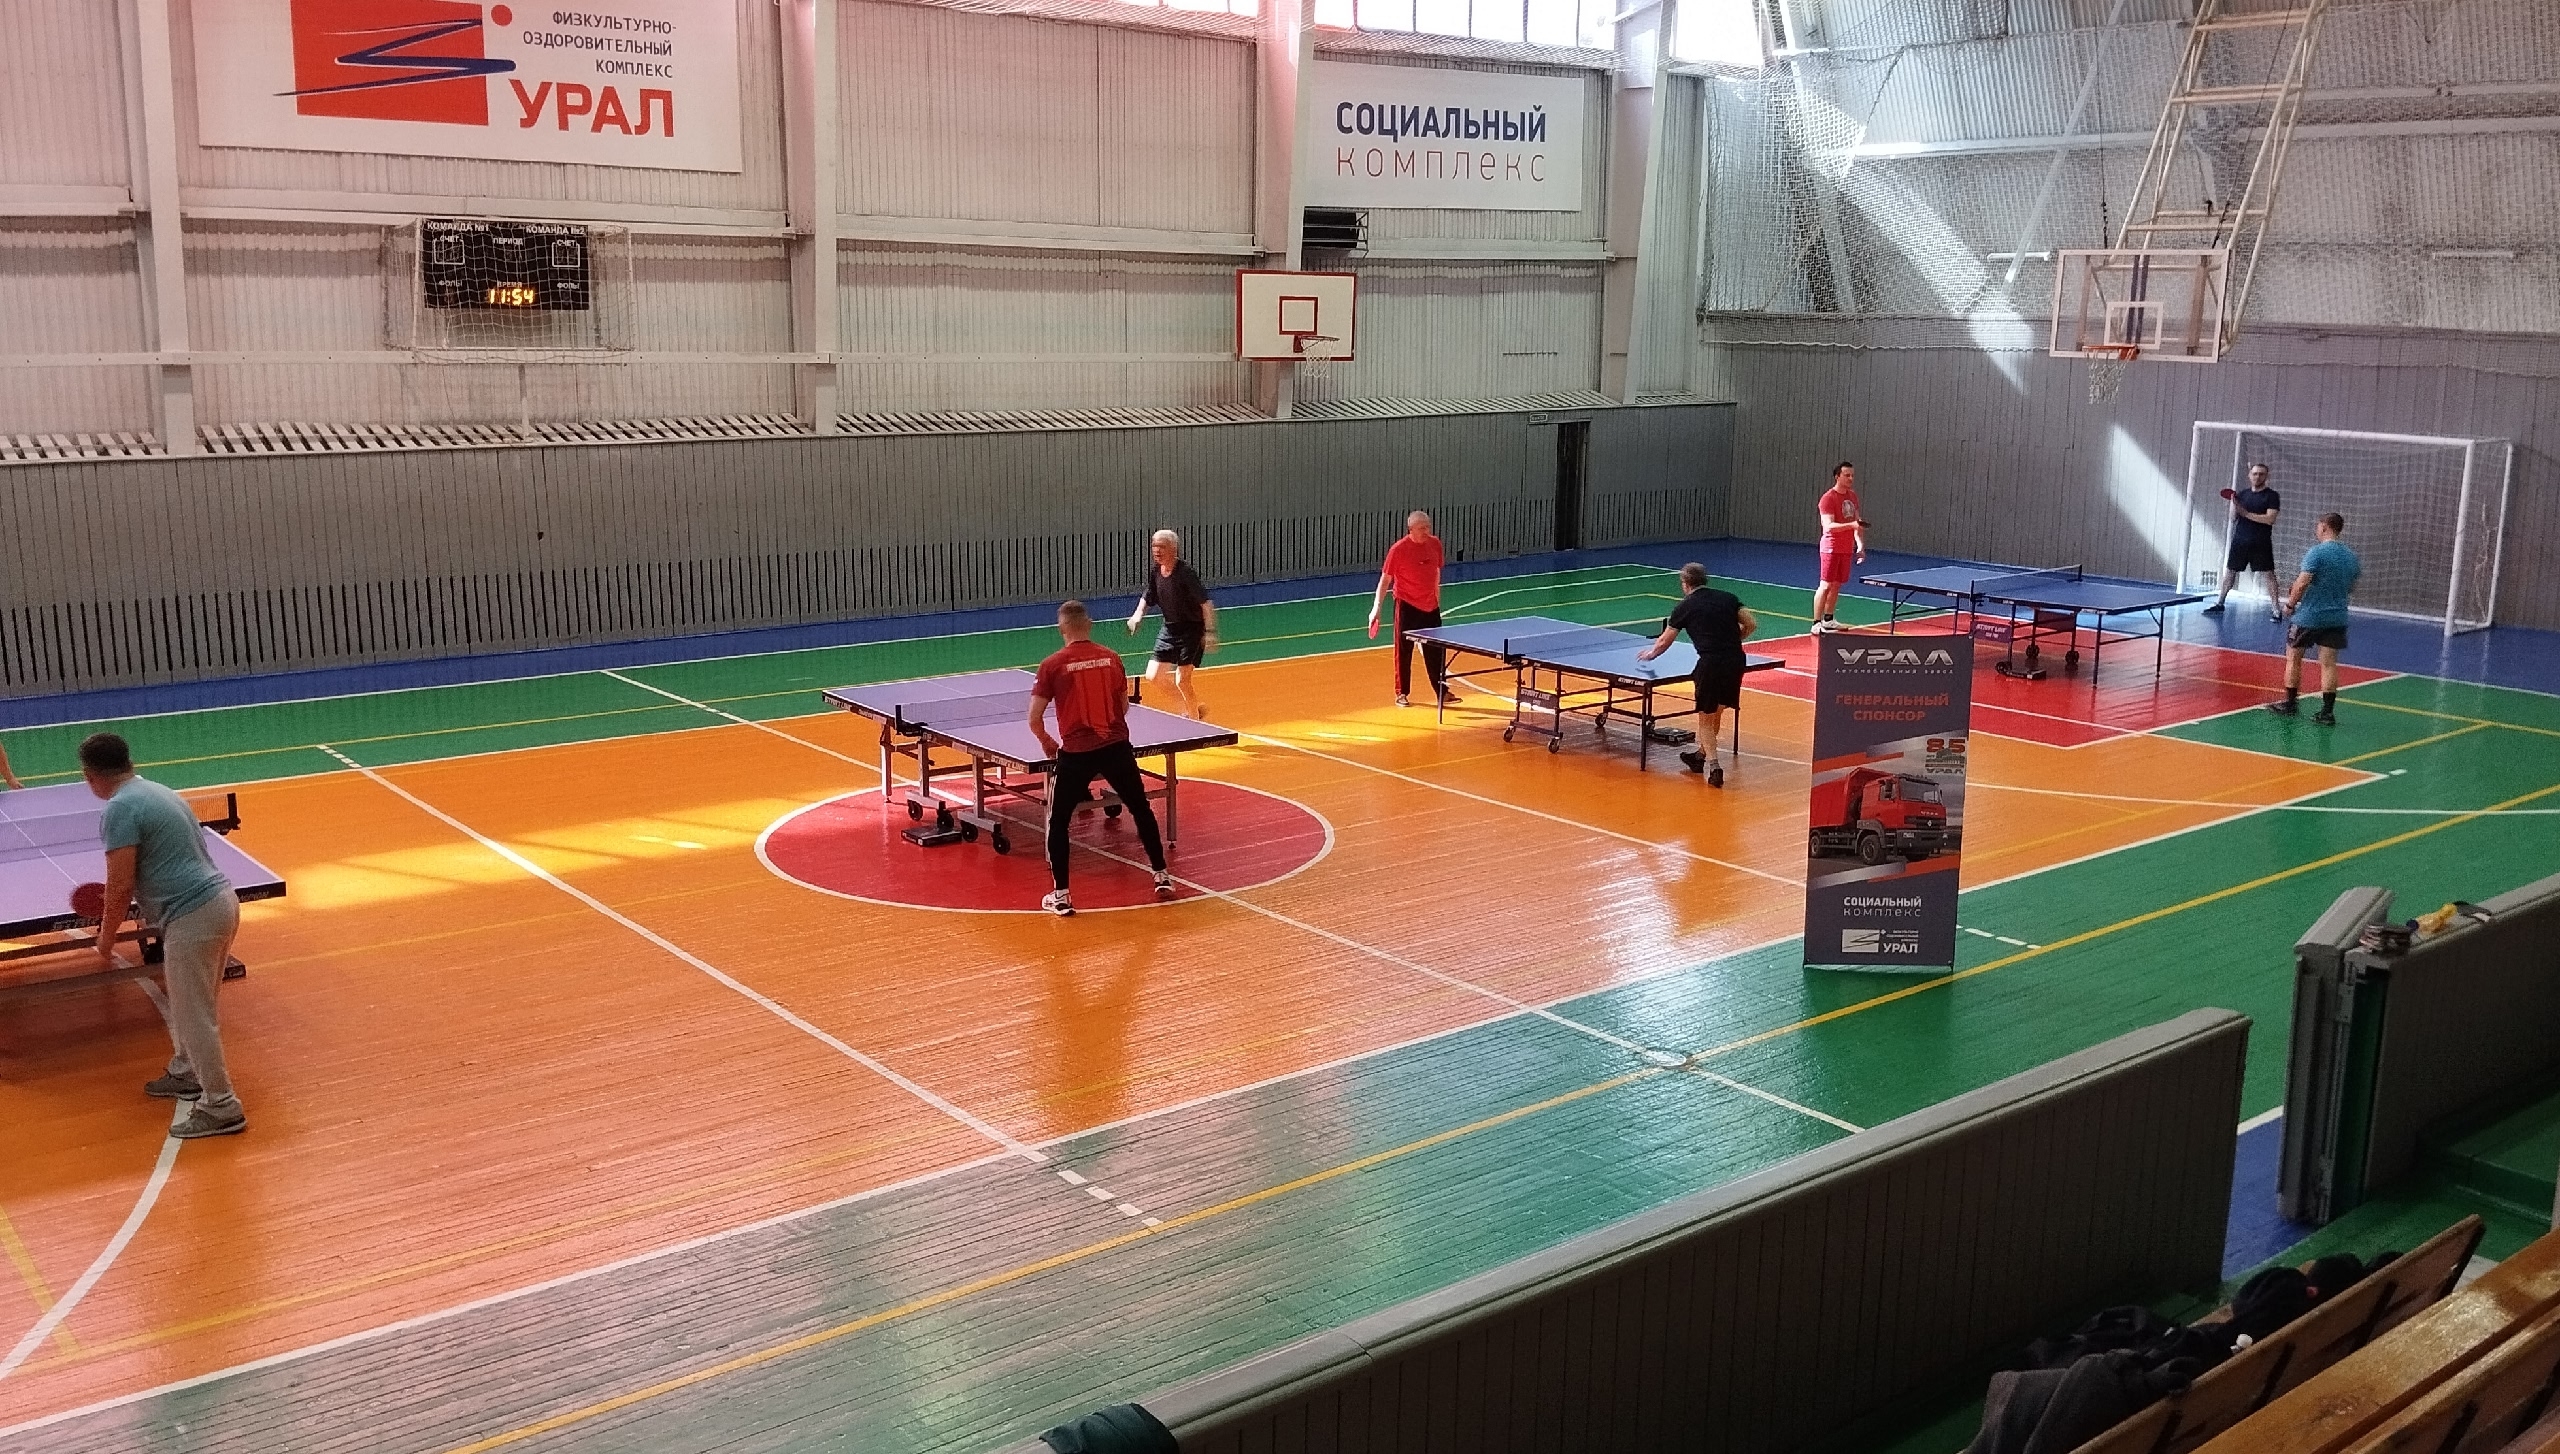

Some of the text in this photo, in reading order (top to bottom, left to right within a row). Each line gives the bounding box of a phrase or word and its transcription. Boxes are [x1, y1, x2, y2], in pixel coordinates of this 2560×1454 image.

[552, 10, 677, 34] ФИЗКУЛЬТУРНО-
[522, 30, 673, 56] ОЗДОРОВИТЕЛЬНЫЙ
[595, 59, 673, 79] КОМПЛЕКС
[508, 79, 675, 138] УРАЛ
[1336, 101, 1546, 143] СОЦИАЛЬНЫЙ
[427, 221, 473, 232] КОМАНДА
[525, 225, 569, 235] КОМАНДА
[493, 237, 524, 246] ПЕРИОД
[556, 239, 576, 247] СЧЕТ
[489, 288, 534, 306] 11:54
[1837, 648, 1954, 666] УРАЛ
[1836, 693, 1949, 706] ГЕНЕРАЛЬНЫЙ
[1853, 710, 1926, 721] СПОНСОР
[1926, 738, 1966, 753] 85
[1843, 895, 1922, 908] СОЦИАЛЬНЫЙ
[1883, 942, 1919, 954] УРАЛ
